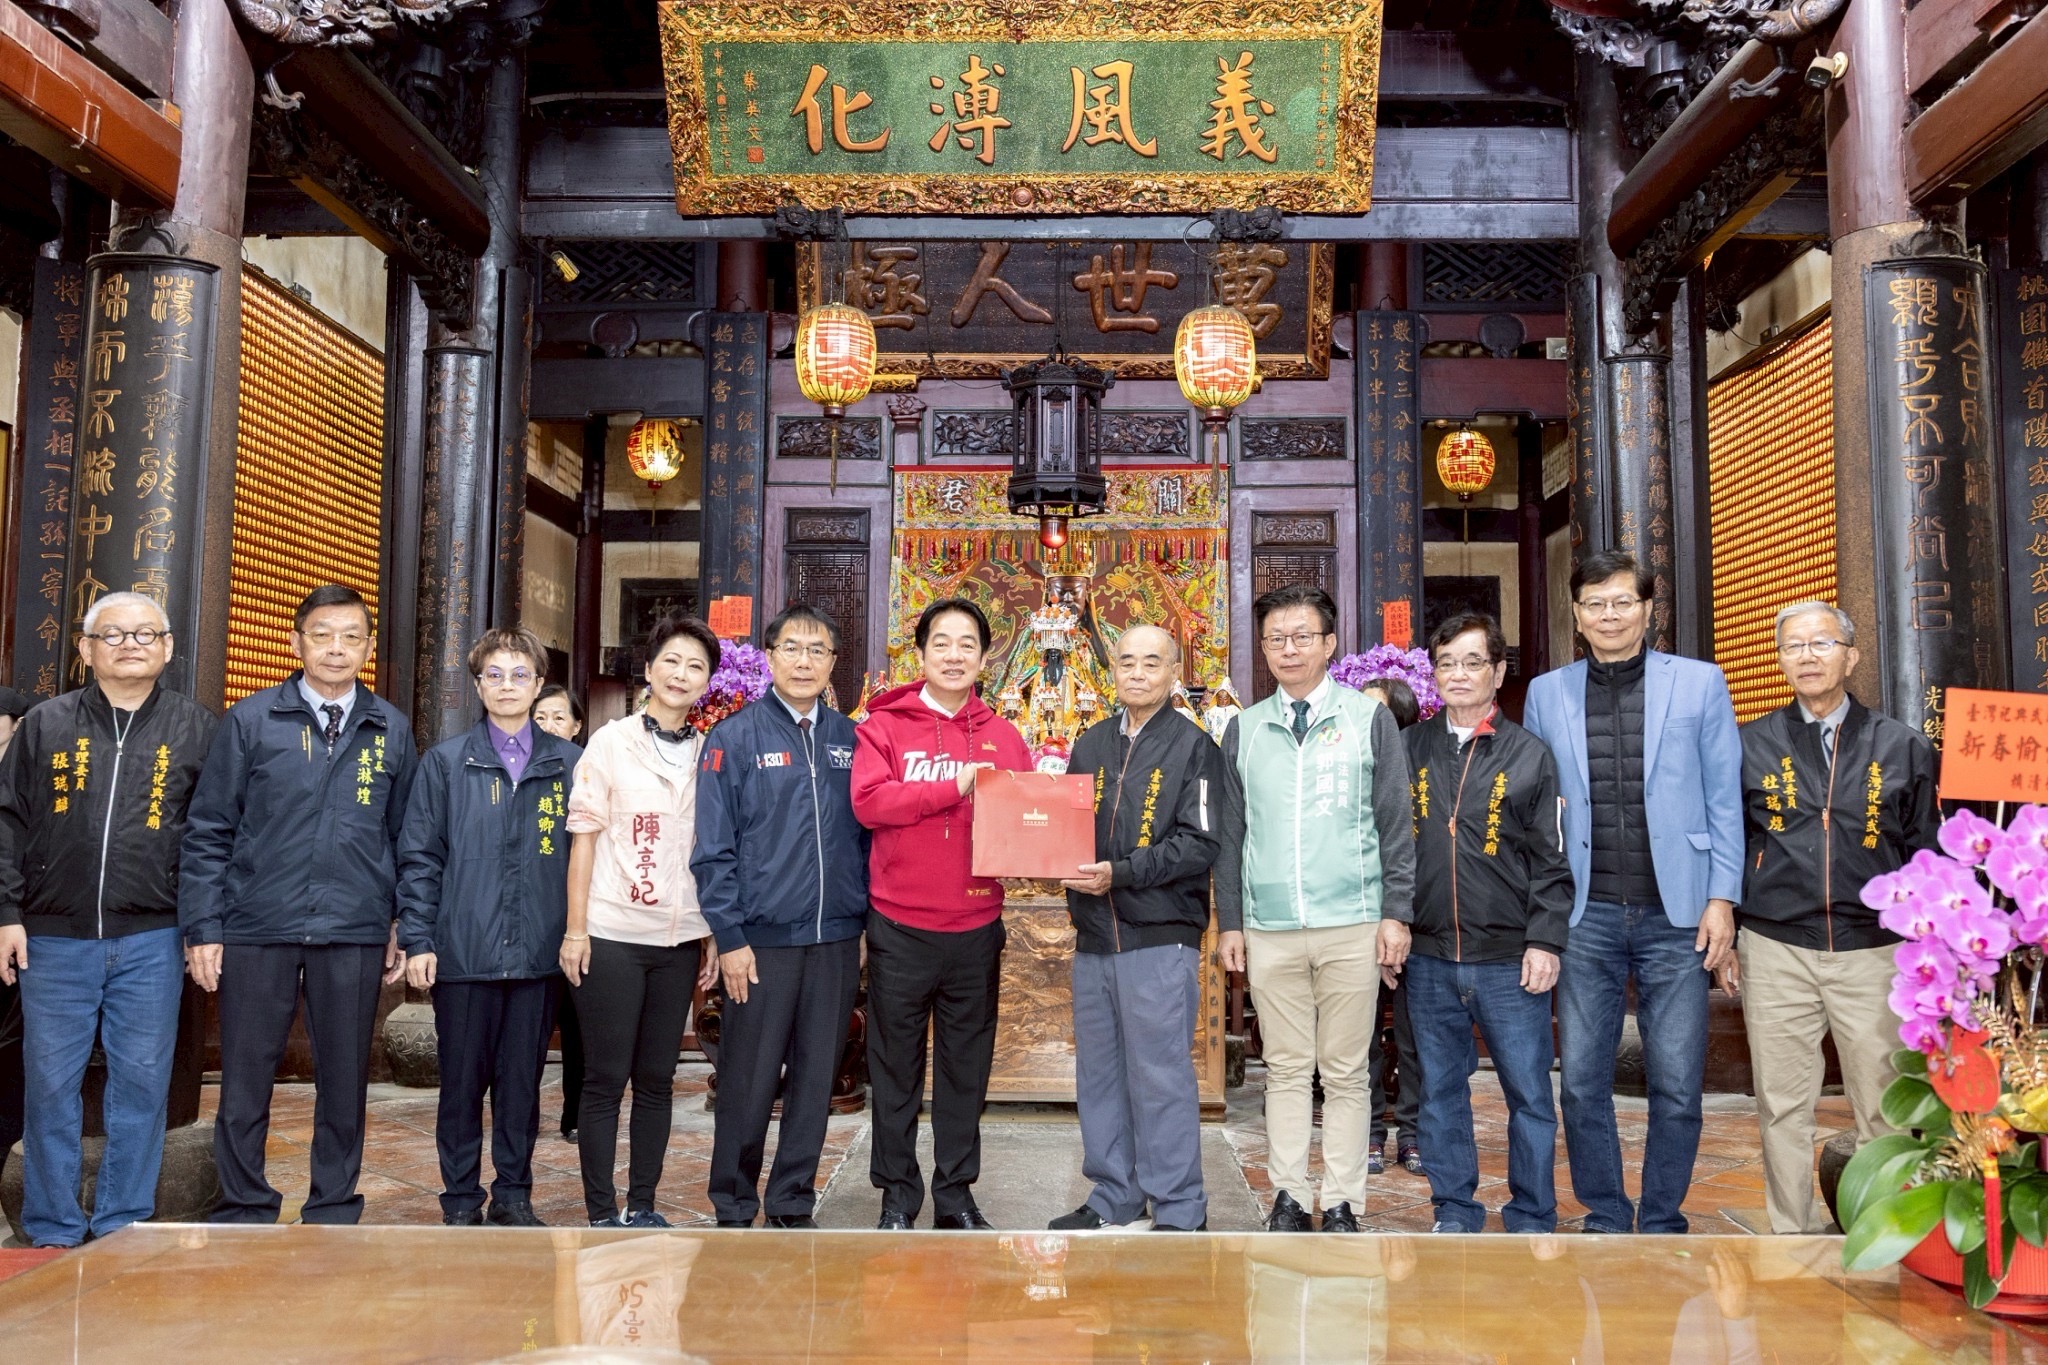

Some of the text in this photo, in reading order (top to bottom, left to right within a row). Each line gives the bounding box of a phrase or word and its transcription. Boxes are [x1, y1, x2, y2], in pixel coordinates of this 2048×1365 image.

[743, 69, 763, 142] 蔡英文
[791, 50, 1279, 166] 義風溥化
[1966, 703, 2048, 725] 臺灣祀典武
[73, 738, 90, 791] 管理委員
[1958, 731, 2048, 761] 新春愉
[1315, 752, 1334, 818] 郭國文
[1781, 756, 1798, 809] 管理委員
[630, 812, 661, 906] 陳亭妃
